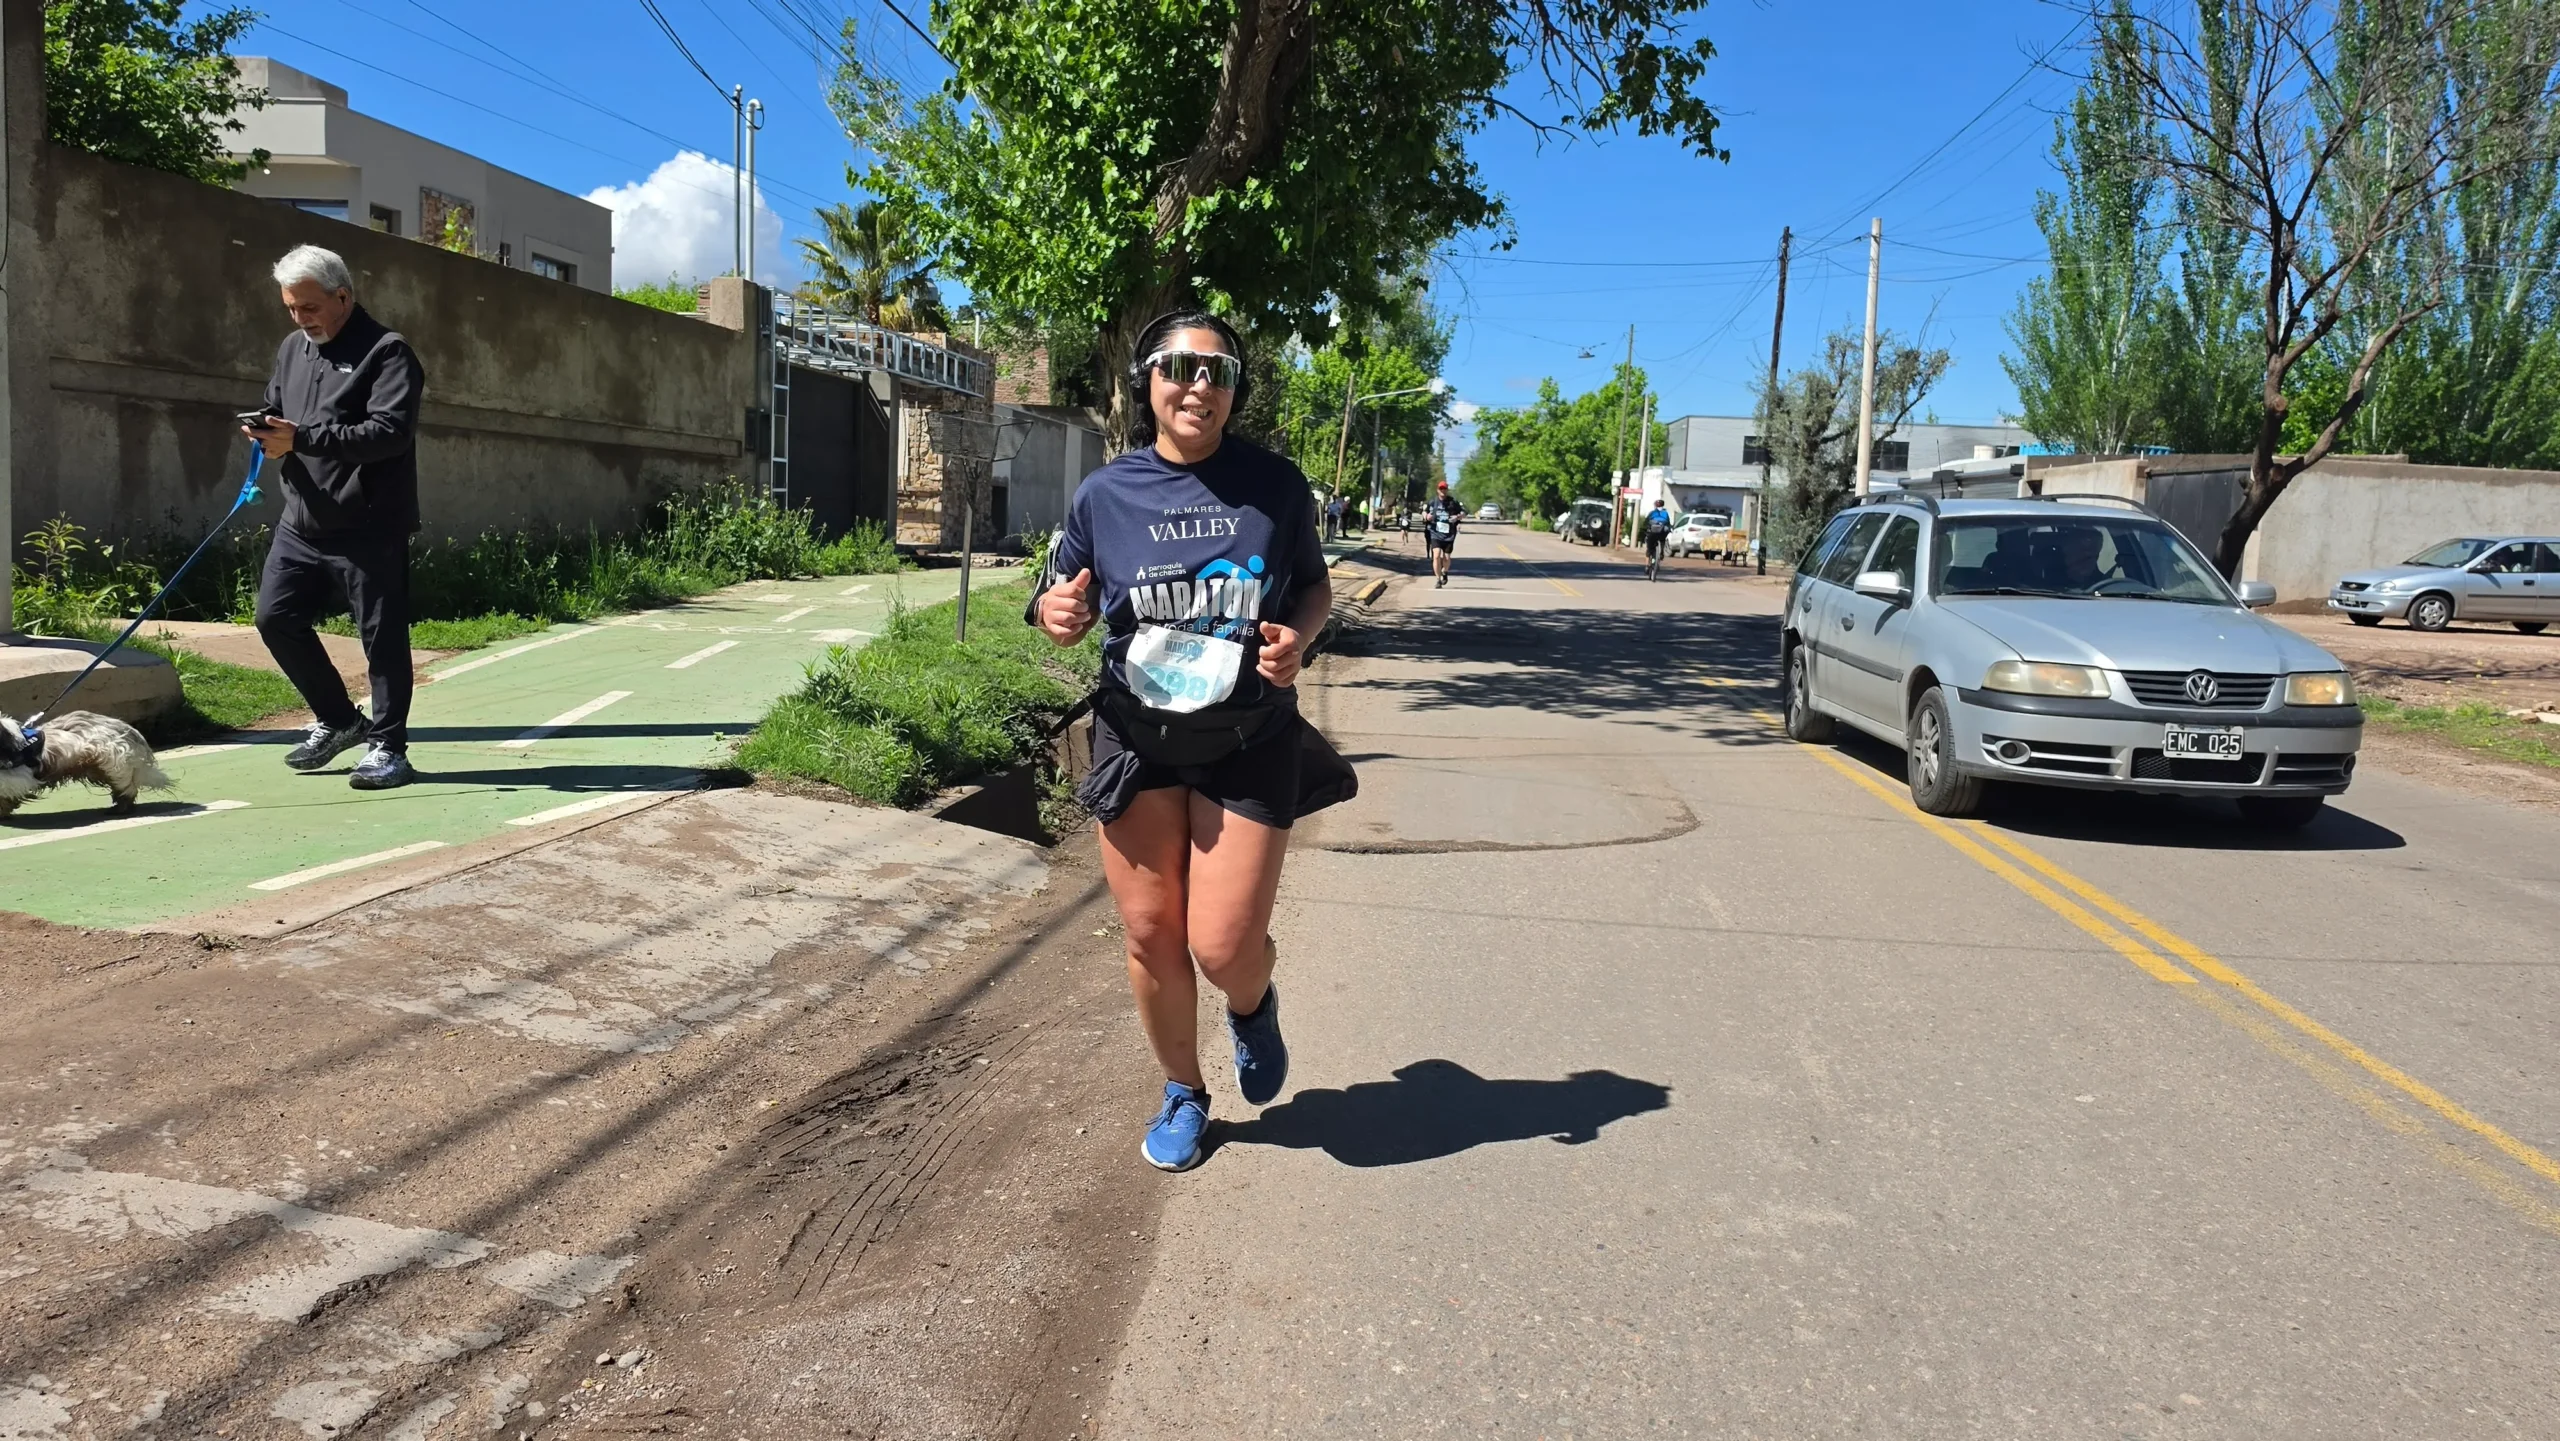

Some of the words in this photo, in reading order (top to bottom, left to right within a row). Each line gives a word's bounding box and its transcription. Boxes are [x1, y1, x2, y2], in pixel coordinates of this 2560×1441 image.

[1163, 505, 1222, 517] PALMARES
[1148, 517, 1241, 542] VALLEY
[1149, 561, 1182, 573] parroquia
[1149, 570, 1158, 578] de
[1159, 569, 1187, 577] chacras
[1129, 567, 1262, 621] MARATÓN
[1198, 620, 1209, 633] la
[1213, 621, 1255, 637] familia
[1143, 667, 1208, 701] 298
[2167, 732, 2198, 752] EMC
[2208, 734, 2240, 754] 025
